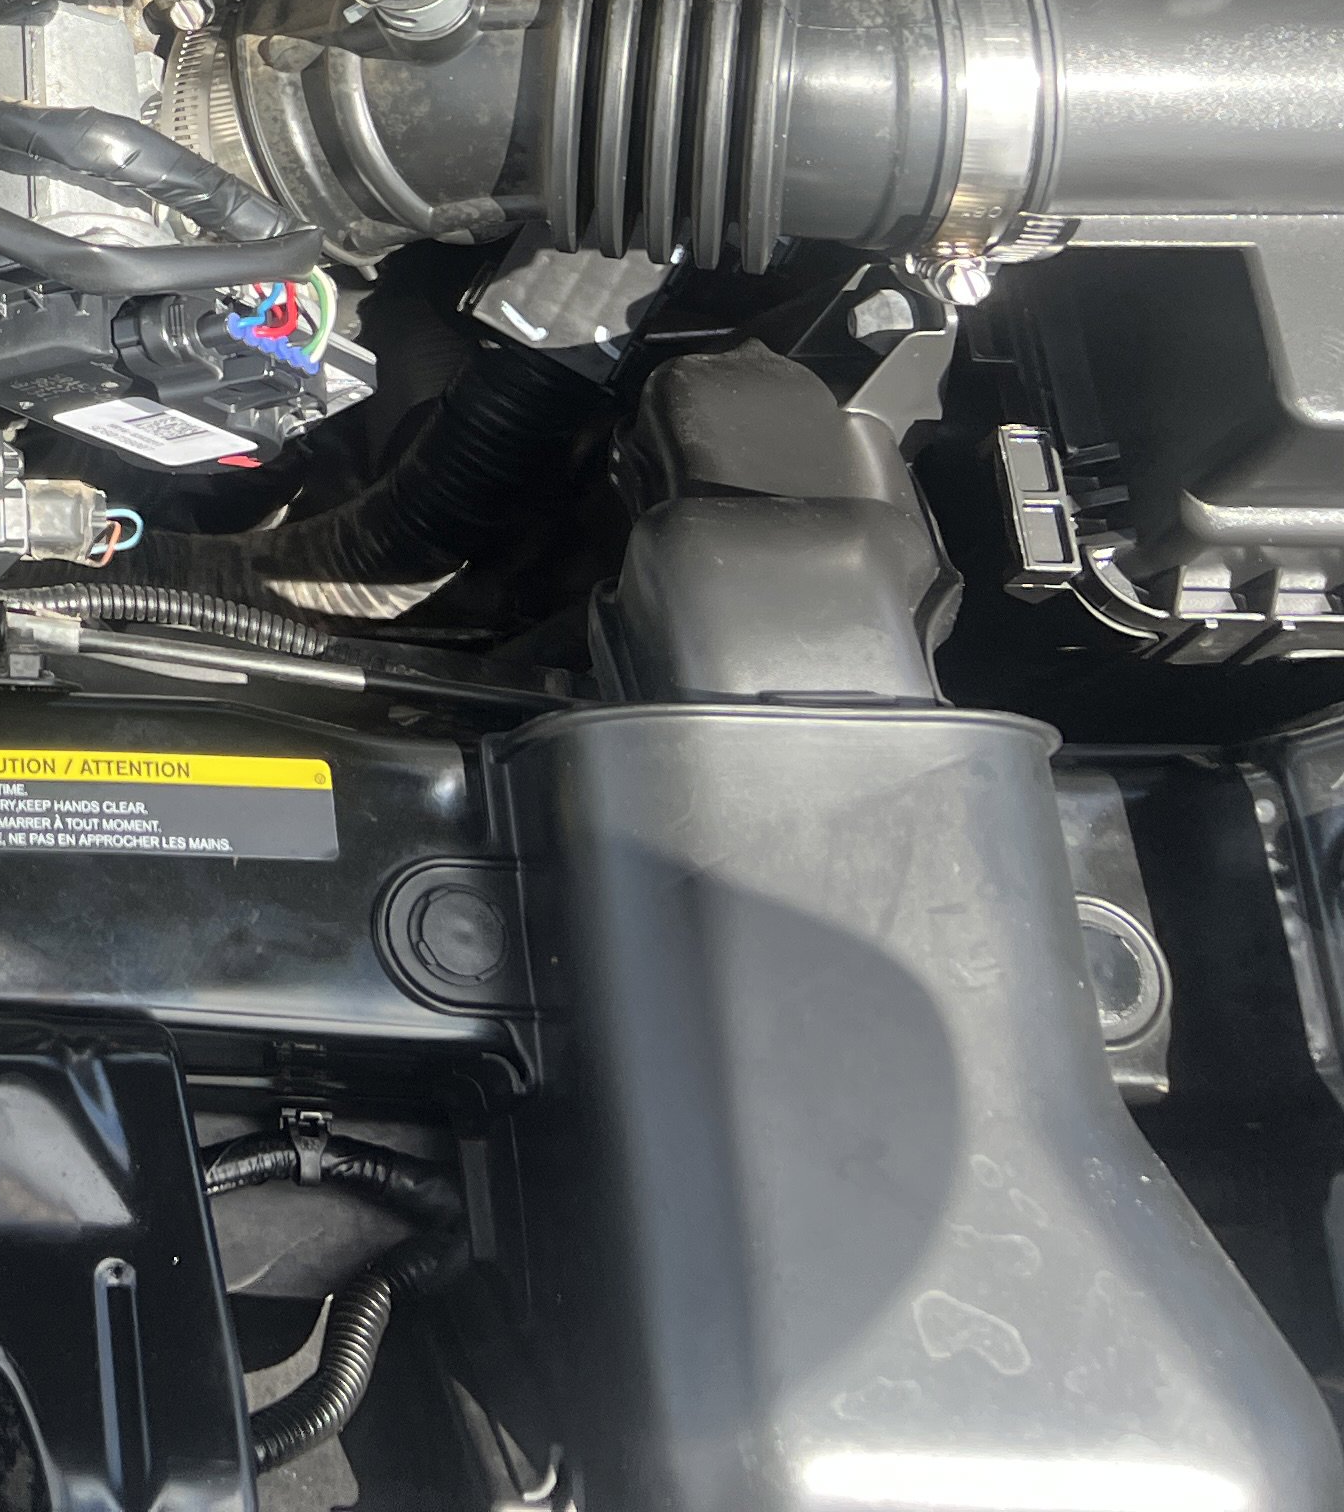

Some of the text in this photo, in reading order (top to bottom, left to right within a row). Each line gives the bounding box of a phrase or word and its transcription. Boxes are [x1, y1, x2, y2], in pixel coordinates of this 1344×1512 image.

[63, 758, 74, 776] /
[79, 758, 192, 779] ATTENTION
[53, 800, 101, 814] HANDS
[102, 801, 149, 815] CLEAR.
[53, 813, 64, 830] À
[65, 817, 100, 832] TOUT
[102, 818, 162, 833] MOMENT.
[8, 831, 27, 846] NE
[29, 832, 55, 847] PAS
[57, 833, 76, 847] EN
[77, 834, 161, 850] APPROCHER
[161, 835, 187, 850] LES
[188, 837, 234, 853] MAINS.
